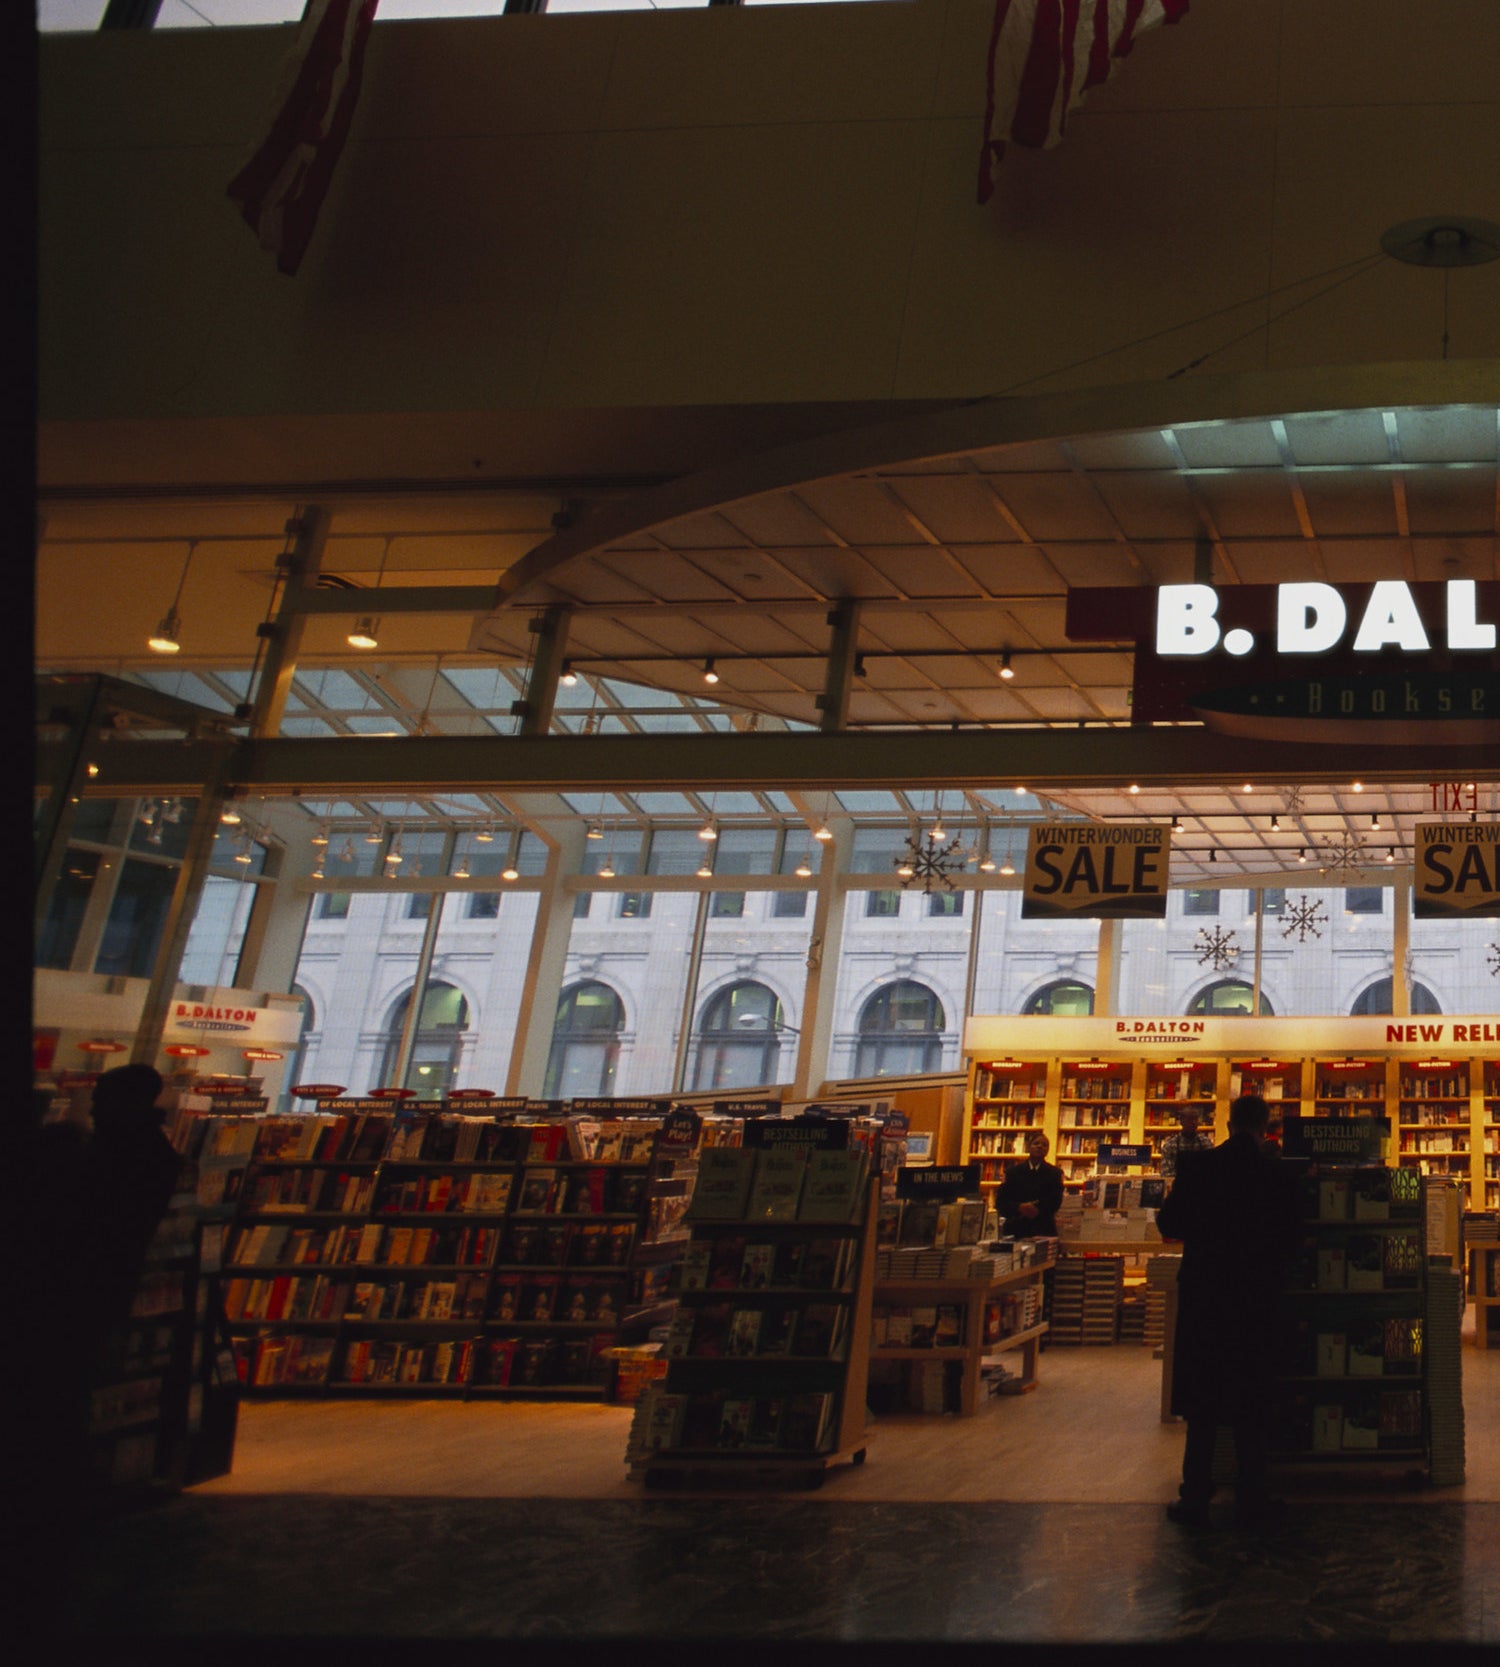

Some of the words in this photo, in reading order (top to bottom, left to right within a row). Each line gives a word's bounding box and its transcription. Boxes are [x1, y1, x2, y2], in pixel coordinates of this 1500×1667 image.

[1032, 845, 1162, 894] SALE
[193, 1006, 256, 1022] DALTON
[1134, 1022, 1204, 1033] DALTON
[1386, 1024, 1444, 1042] NEW
[763, 1127, 828, 1141] BESTSELLING
[1303, 1125, 1370, 1138] BESTSELLING
[1313, 1139, 1360, 1152] AUTHORS
[913, 1172, 922, 1183] IN
[924, 1172, 939, 1183] THE
[941, 1171, 964, 1183] NEWS
